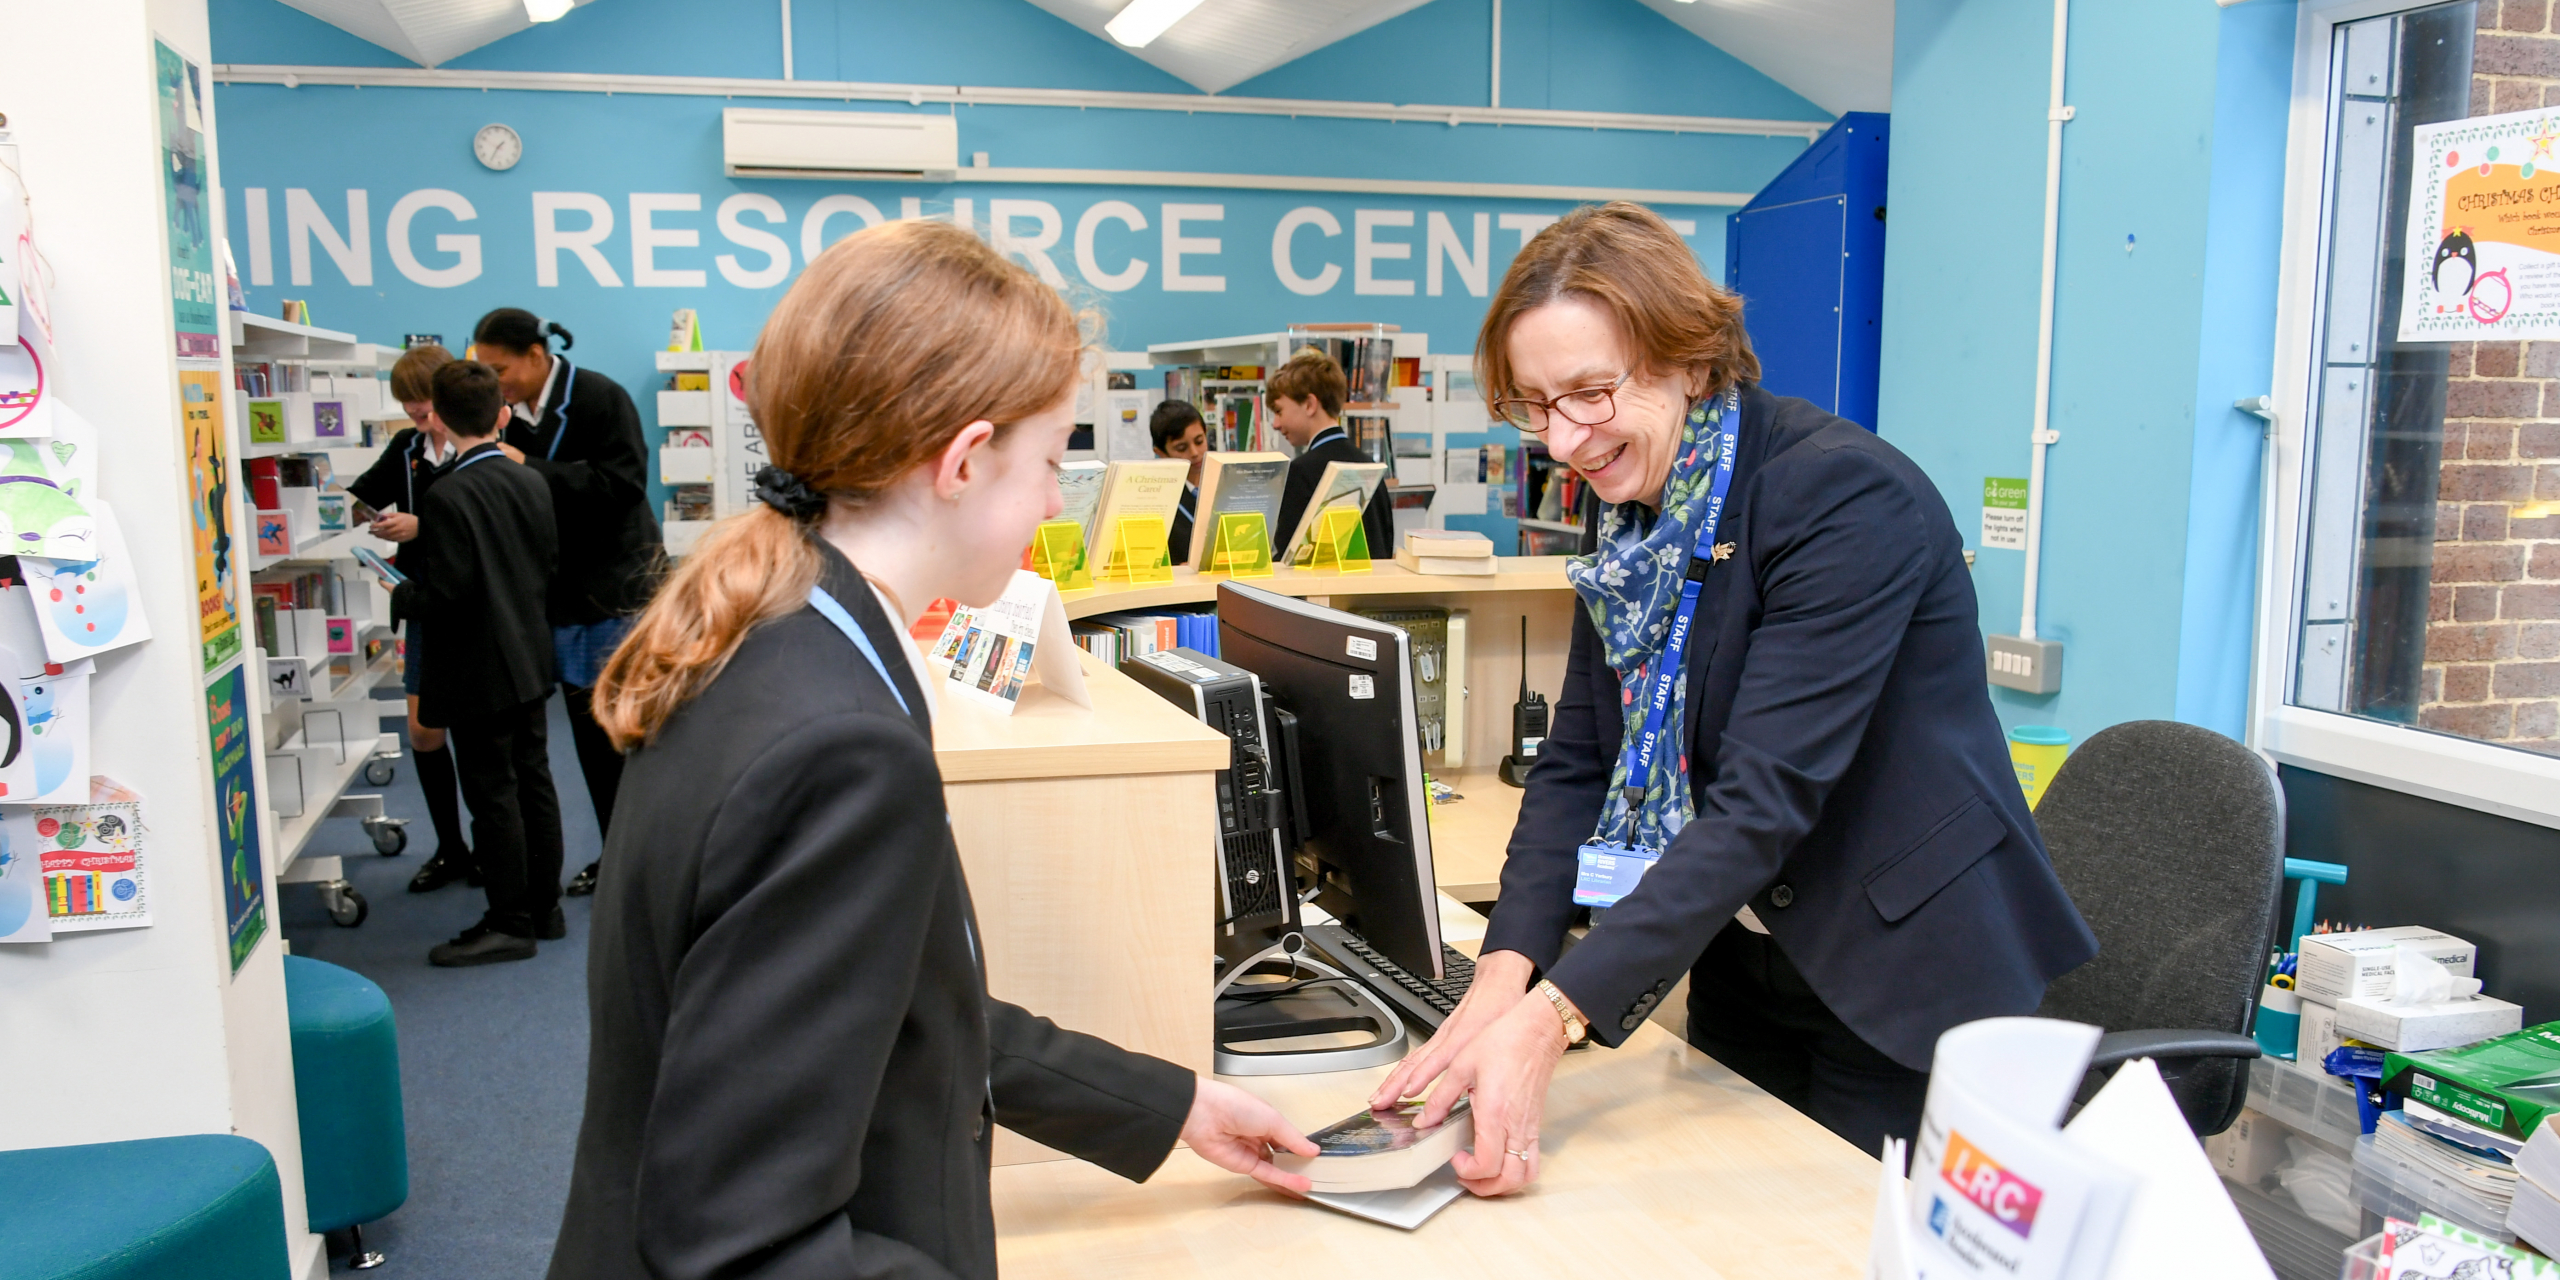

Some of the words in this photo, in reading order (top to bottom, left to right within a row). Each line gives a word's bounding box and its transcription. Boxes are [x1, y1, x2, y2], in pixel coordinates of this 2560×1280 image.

[2458, 187, 2535, 211] CHRISTMAS
[2498, 212, 2520, 223] Which
[2522, 209, 2541, 221] book
[220, 187, 483, 288] ING
[2518, 262, 2539, 271] Collect
[2546, 262, 2556, 270] gift
[1720, 433, 1735, 472] STAFF
[1126, 476, 1134, 484] A
[1134, 475, 1178, 484] Christmas
[1138, 485, 1162, 493] Carol
[1705, 496, 1722, 534] STAFF
[1985, 513, 2003, 521] Please
[1994, 524, 2008, 533] lights
[1670, 614, 1688, 652] STAFF
[1654, 673, 1671, 711] STAFF
[1639, 732, 1655, 768] STAFF
[41, 857, 76, 869] HAPPY
[81, 855, 135, 867] CHRISTMAS
[2452, 1101, 2490, 1123] Multicopy
[1951, 1147, 2027, 1223] LRC
